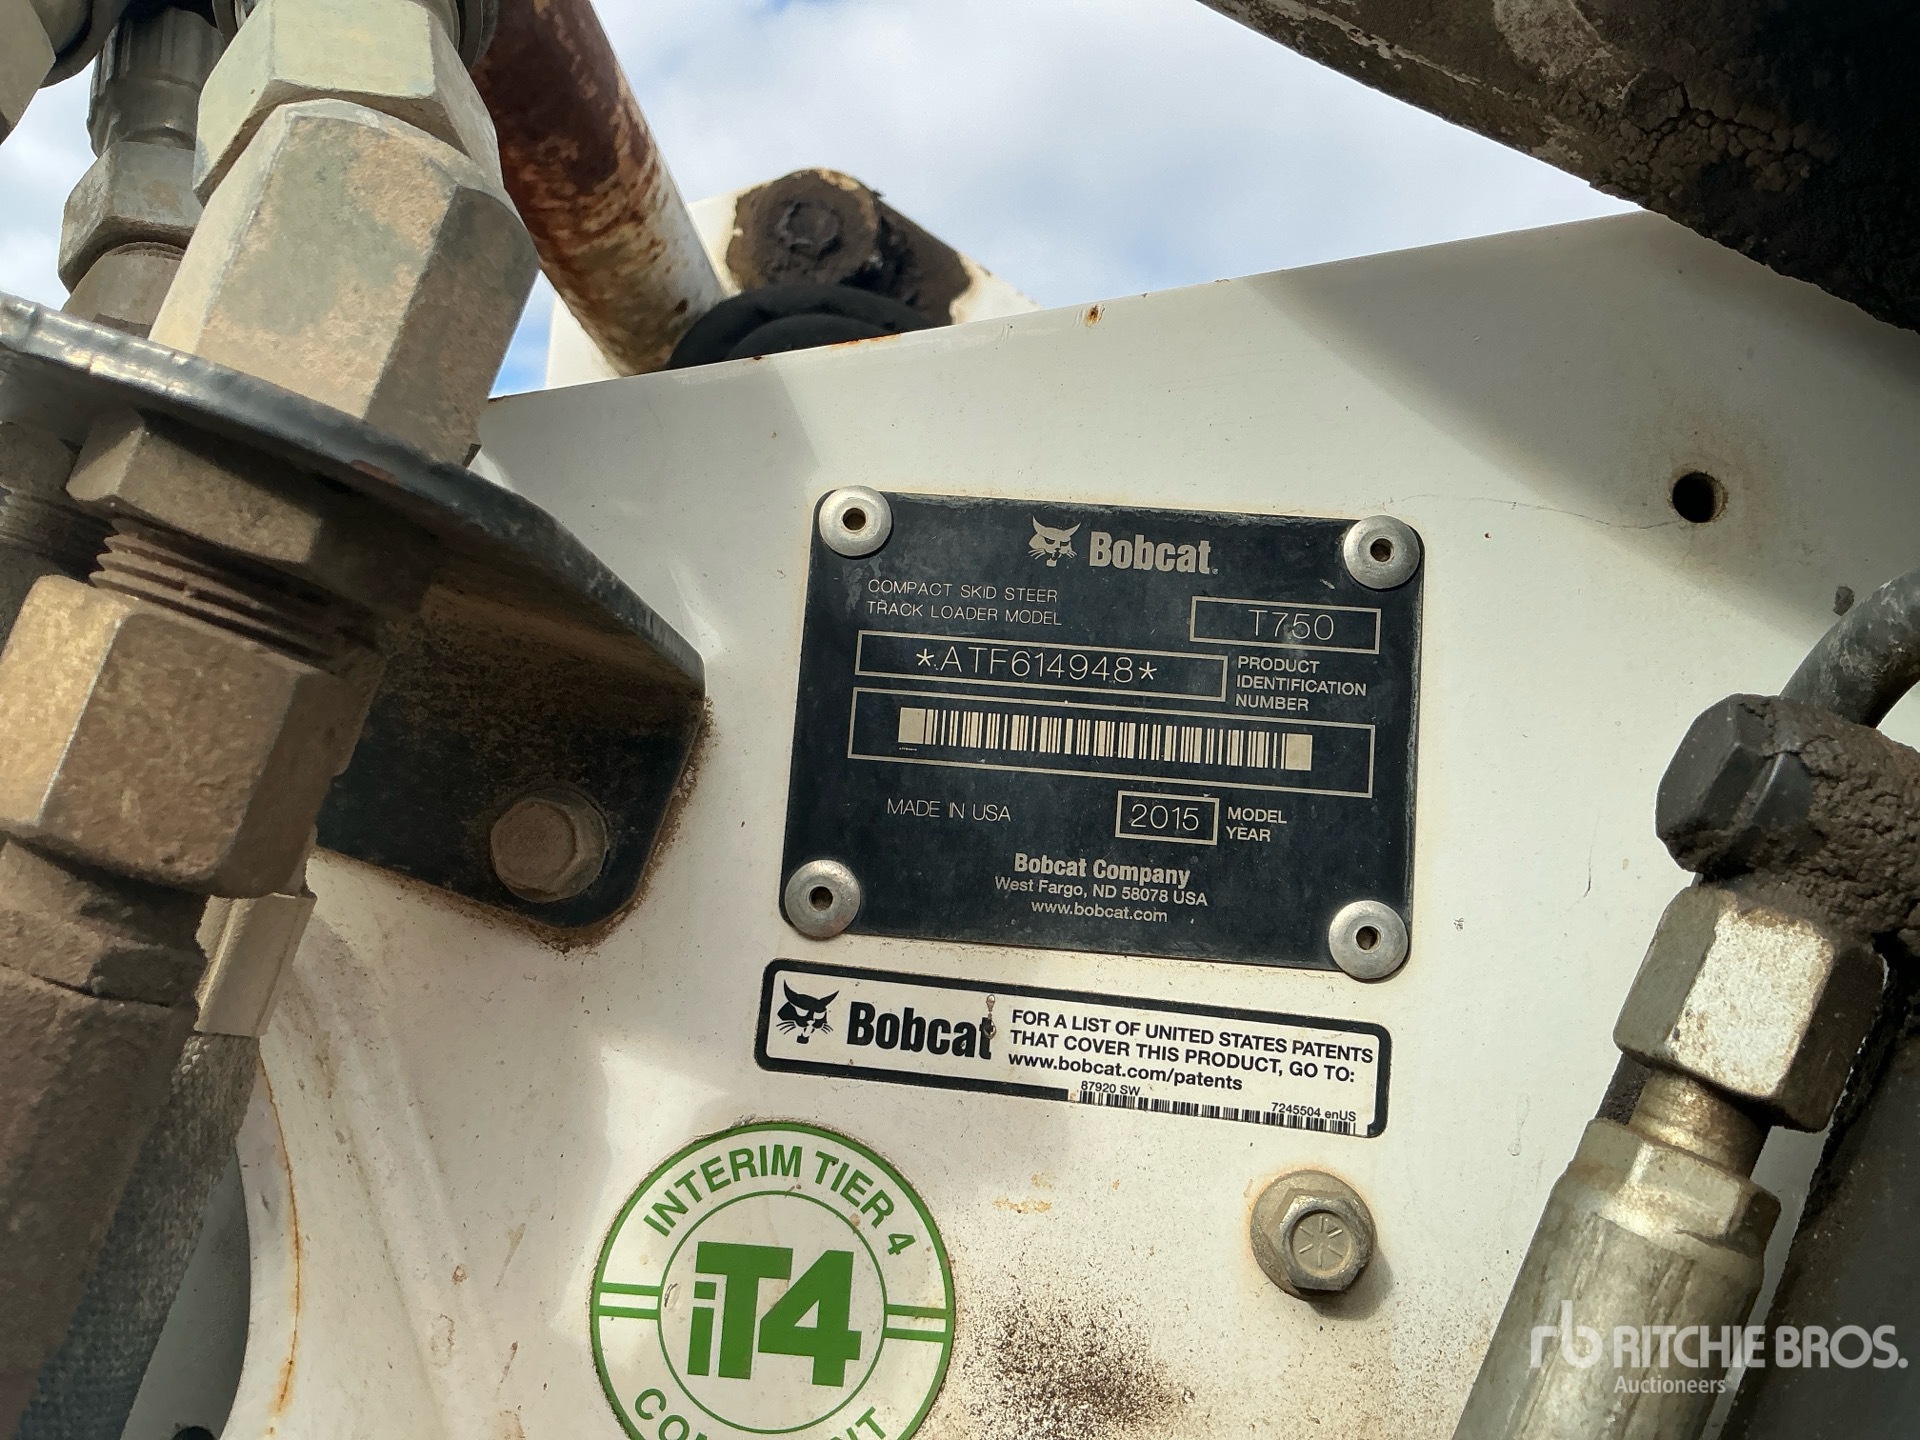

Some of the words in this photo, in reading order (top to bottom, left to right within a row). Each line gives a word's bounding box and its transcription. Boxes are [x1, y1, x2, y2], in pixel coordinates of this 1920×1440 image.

[868, 580, 951, 599] COMPACT
[960, 584, 998, 601] SKID
[1005, 586, 1058, 603] STEER
[867, 601, 924, 618] TRACK
[930, 604, 999, 622] LOADER
[1005, 607, 1063, 626] MODEL
[1249, 610, 1334, 641] T750
[1238, 656, 1320, 674] PRODUCT
[1236, 675, 1368, 697] IDENTIFICATION
[1235, 694, 1310, 712] NUMBER
[887, 798, 941, 819] MADE
[948, 801, 968, 820] IN
[971, 802, 1011, 822] USA
[1130, 804, 1200, 831] 2015
[1227, 807, 1288, 825] MODEL
[1226, 825, 1271, 842] YEAR
[1014, 852, 1087, 877] Bobcat
[1093, 858, 1191, 887] Company
[995, 876, 1035, 892] West
[1038, 879, 1088, 901] Fargo,
[1092, 882, 1117, 899] ND
[1121, 884, 1169, 903] 58078
[1173, 889, 1208, 906] USA
[1030, 899, 1168, 924] www.bobcat.com
[846, 1000, 994, 1062] Bobcat
[1011, 1009, 1052, 1028] FOR
[1053, 1014, 1068, 1030] A
[1072, 1015, 1111, 1034] LIST
[1114, 1019, 1140, 1036] OF
[1144, 1021, 1216, 1044] UNITED
[1219, 1030, 1289, 1052] STATES
[1292, 1038, 1374, 1064] PATENTS
[1010, 1030, 1061, 1049] THAT
[1064, 1034, 1130, 1056] COVER
[1135, 1042, 1179, 1061] THIS
[1184, 1046, 1284, 1077] PRODUCT,
[1288, 1059, 1318, 1078] GO
[1323, 1063, 1356, 1083] TO:
[1008, 1053, 1243, 1091] www.bobcat.com/patents
[1080, 1080, 1117, 1095] 87920
[1119, 1084, 1141, 1097] SW
[1271, 1102, 1322, 1119] 7245504
[1324, 1108, 1357, 1123] enUS
[643, 1144, 803, 1237] INTERIM
[814, 1150, 895, 1228] TIER
[887, 1232, 916, 1256] 4
[687, 1240, 862, 1388] iT4
